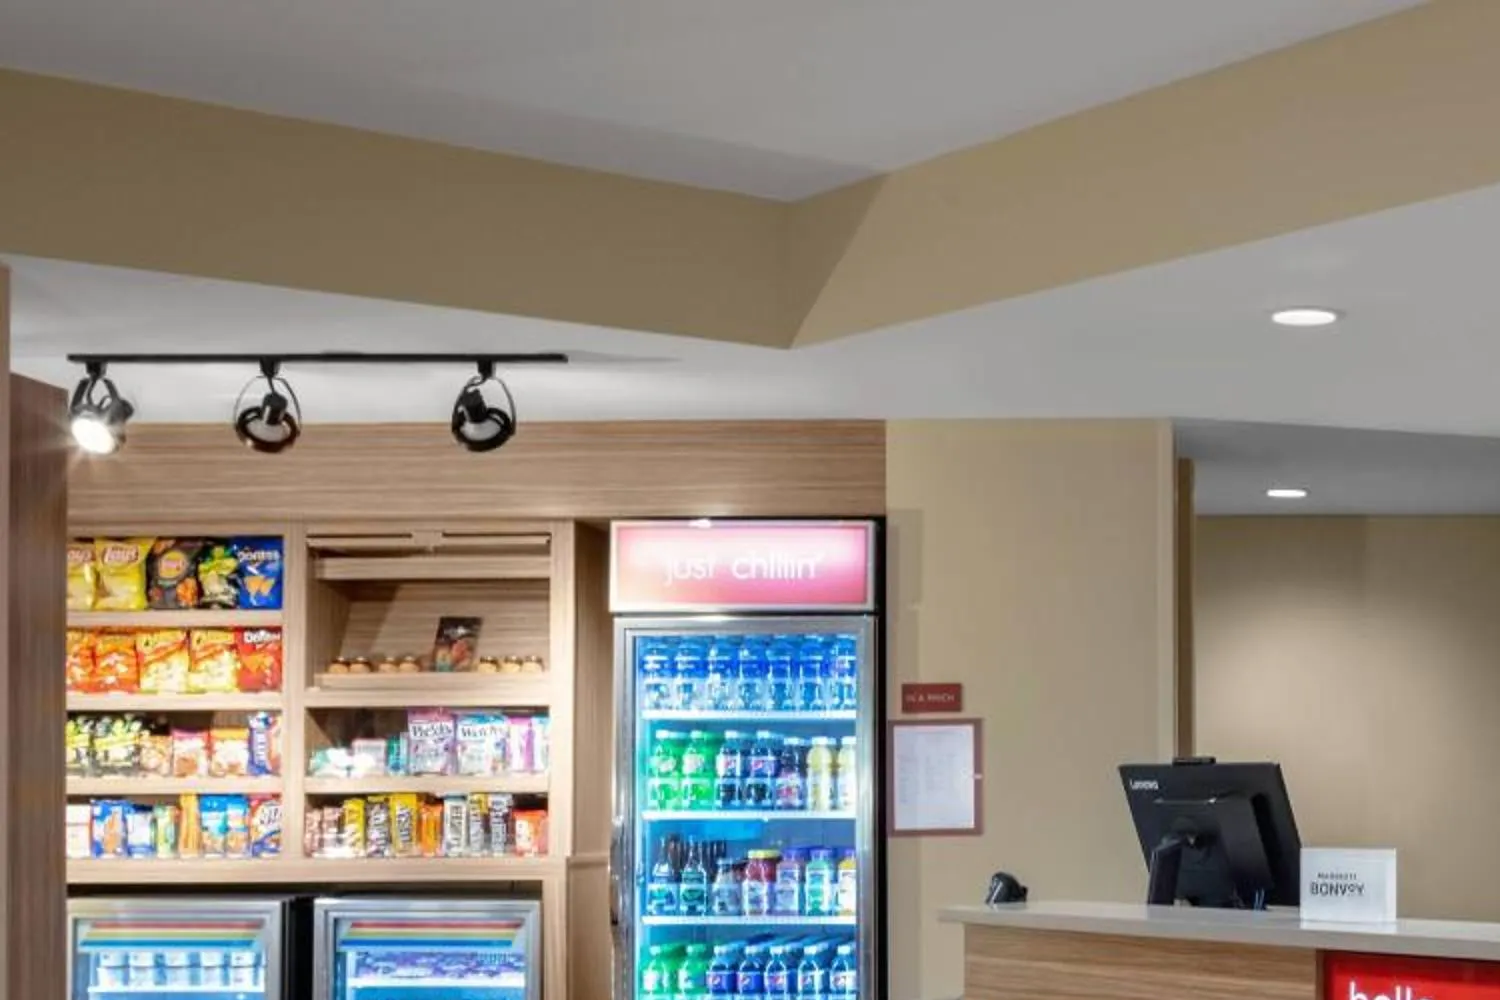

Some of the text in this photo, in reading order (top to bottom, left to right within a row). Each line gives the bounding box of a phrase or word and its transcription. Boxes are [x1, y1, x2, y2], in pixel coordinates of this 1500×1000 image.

[664, 551, 716, 586] just
[1129, 778, 1159, 790] Lenovo
[1310, 882, 1365, 896] BONVOY
